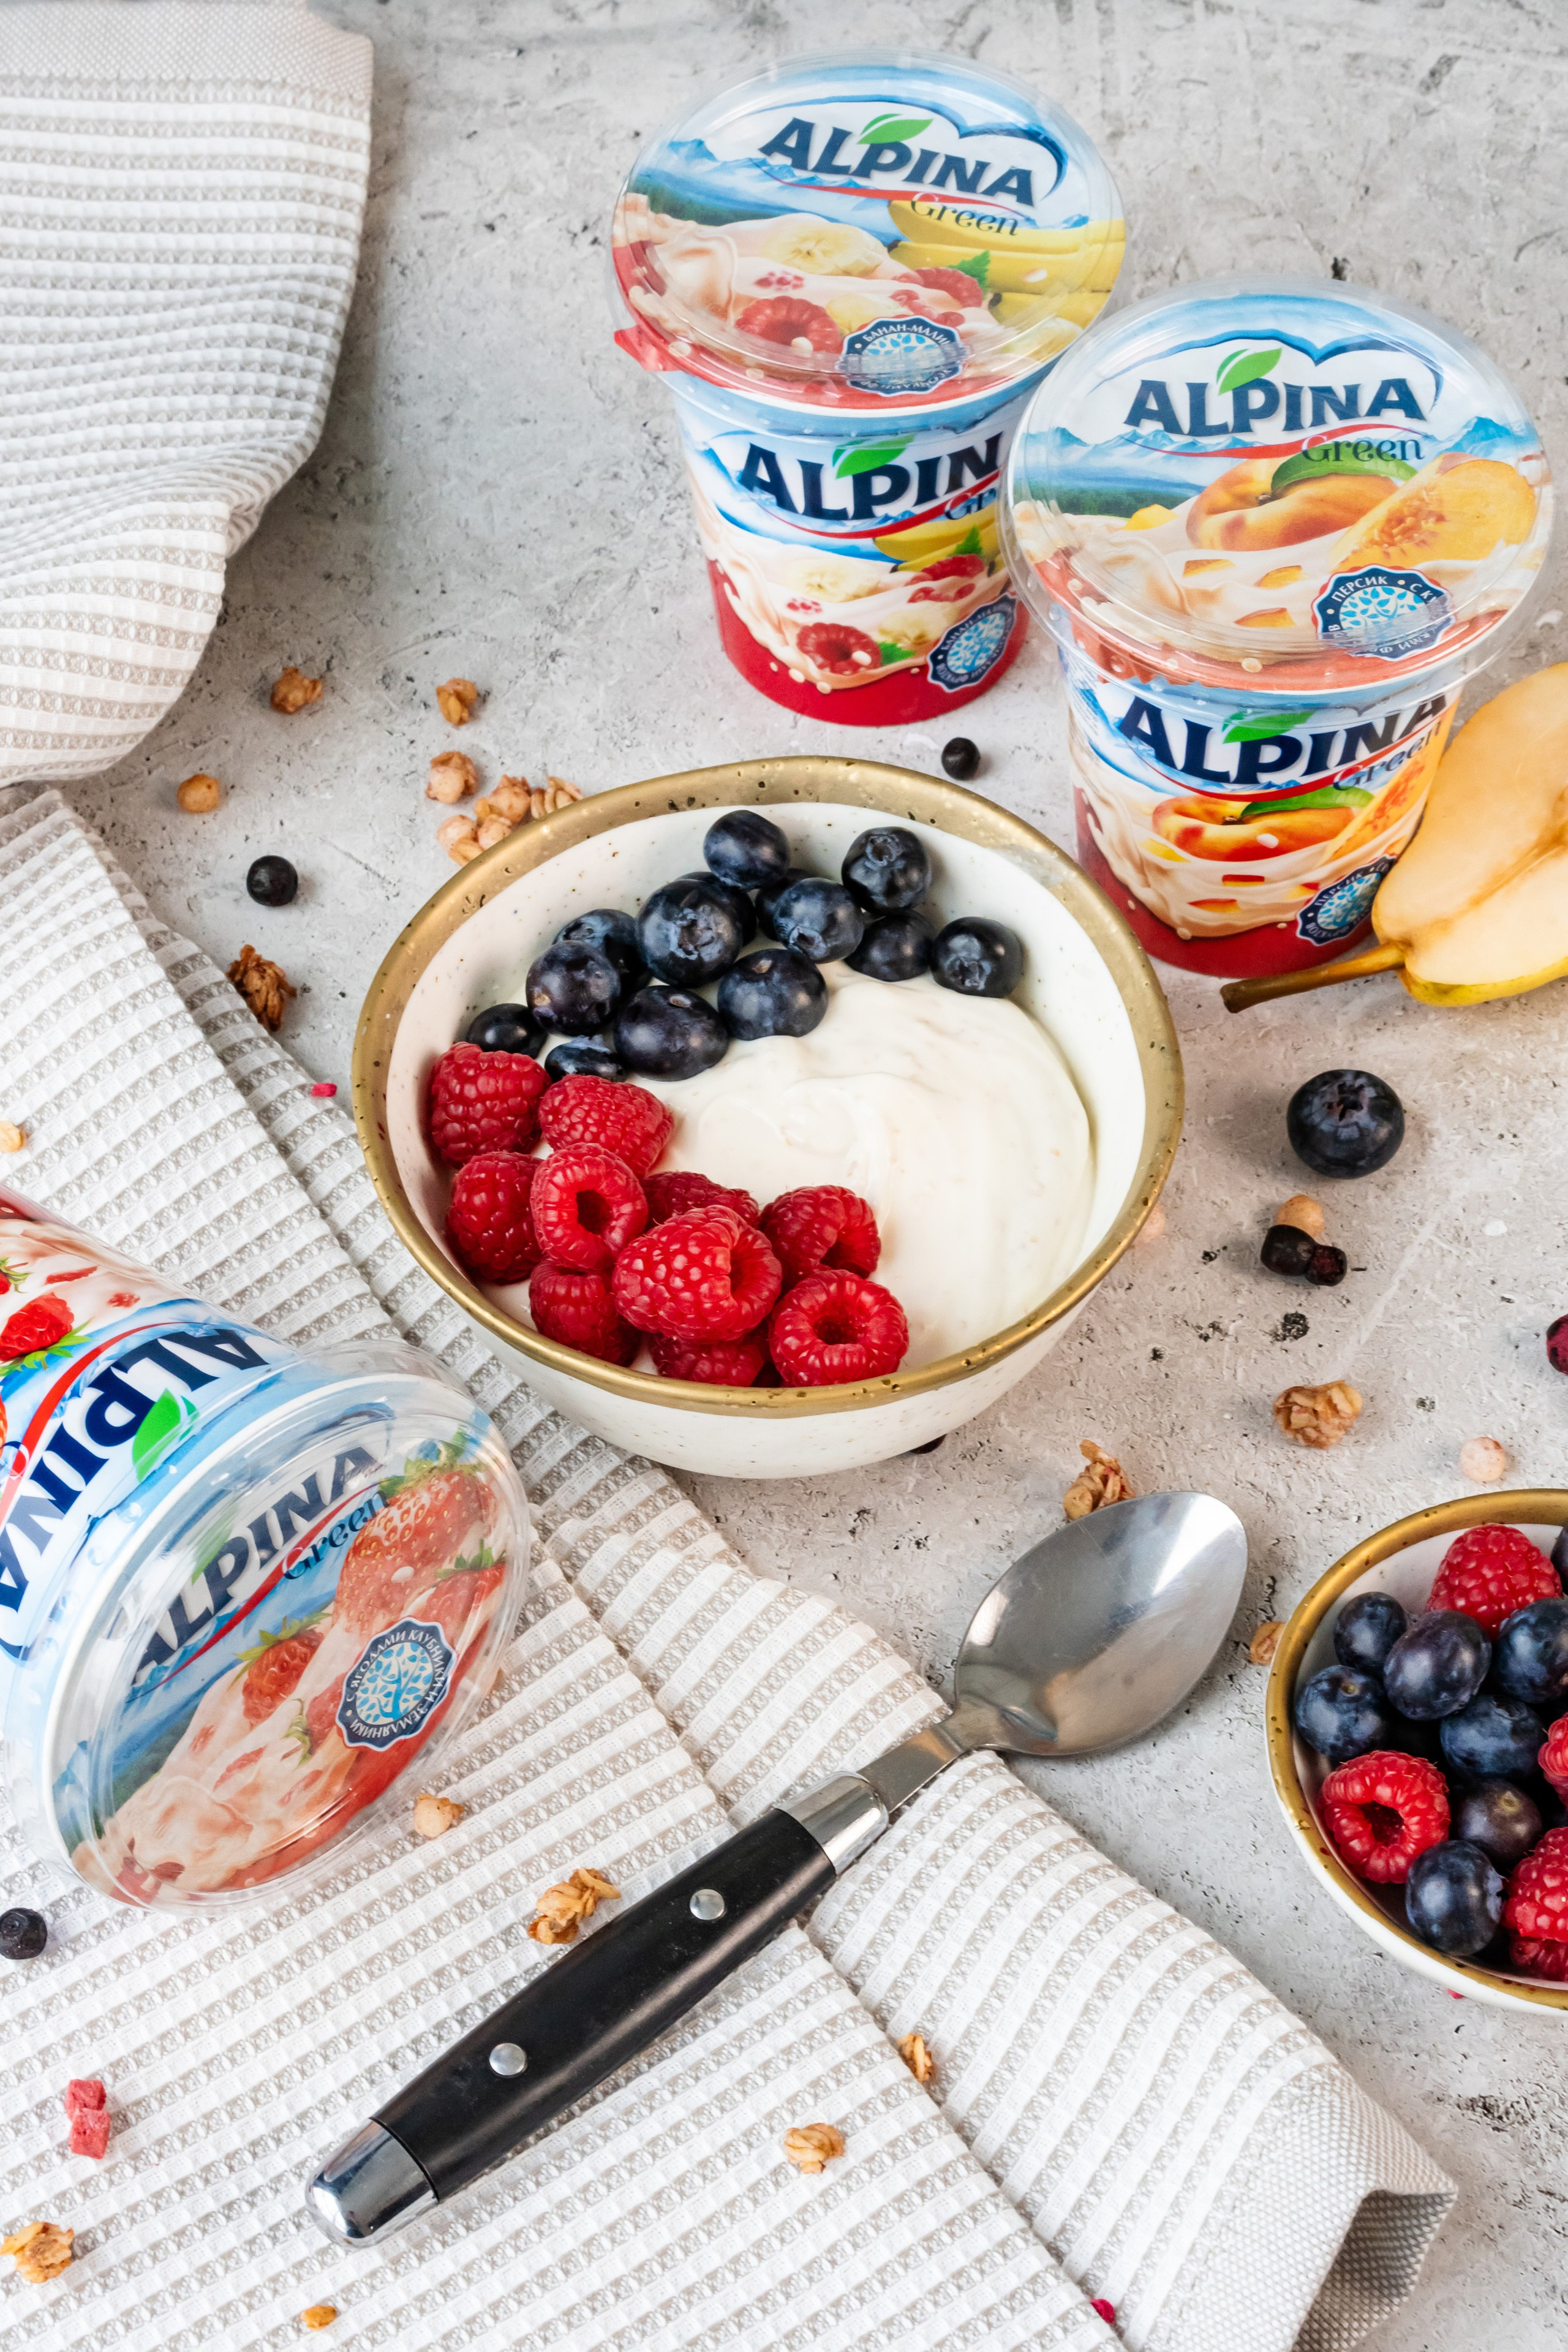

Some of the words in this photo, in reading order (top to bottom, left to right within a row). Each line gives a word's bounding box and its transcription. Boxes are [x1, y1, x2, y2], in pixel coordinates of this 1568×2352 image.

[760, 116, 1035, 208] ALPINA
[911, 192, 1019, 236] Green
[862, 323, 951, 345] БАНАН-МАЛИ
[1123, 377, 1429, 437] ALPINA
[737, 431, 1004, 521] ALPIN
[1302, 434, 1425, 463] Green
[1331, 575, 1389, 603] ПЕРСИК
[1119, 692, 1447, 785] ALPINA
[1333, 721, 1442, 791] Green
[282, 1489, 391, 1580] Green
[350, 1630, 407, 1688] ЯГОДАМИ
[408, 1629, 445, 1687] КЛУБНИКИ
[350, 1703, 429, 1739] ЗЕМЛЯНИКИ
